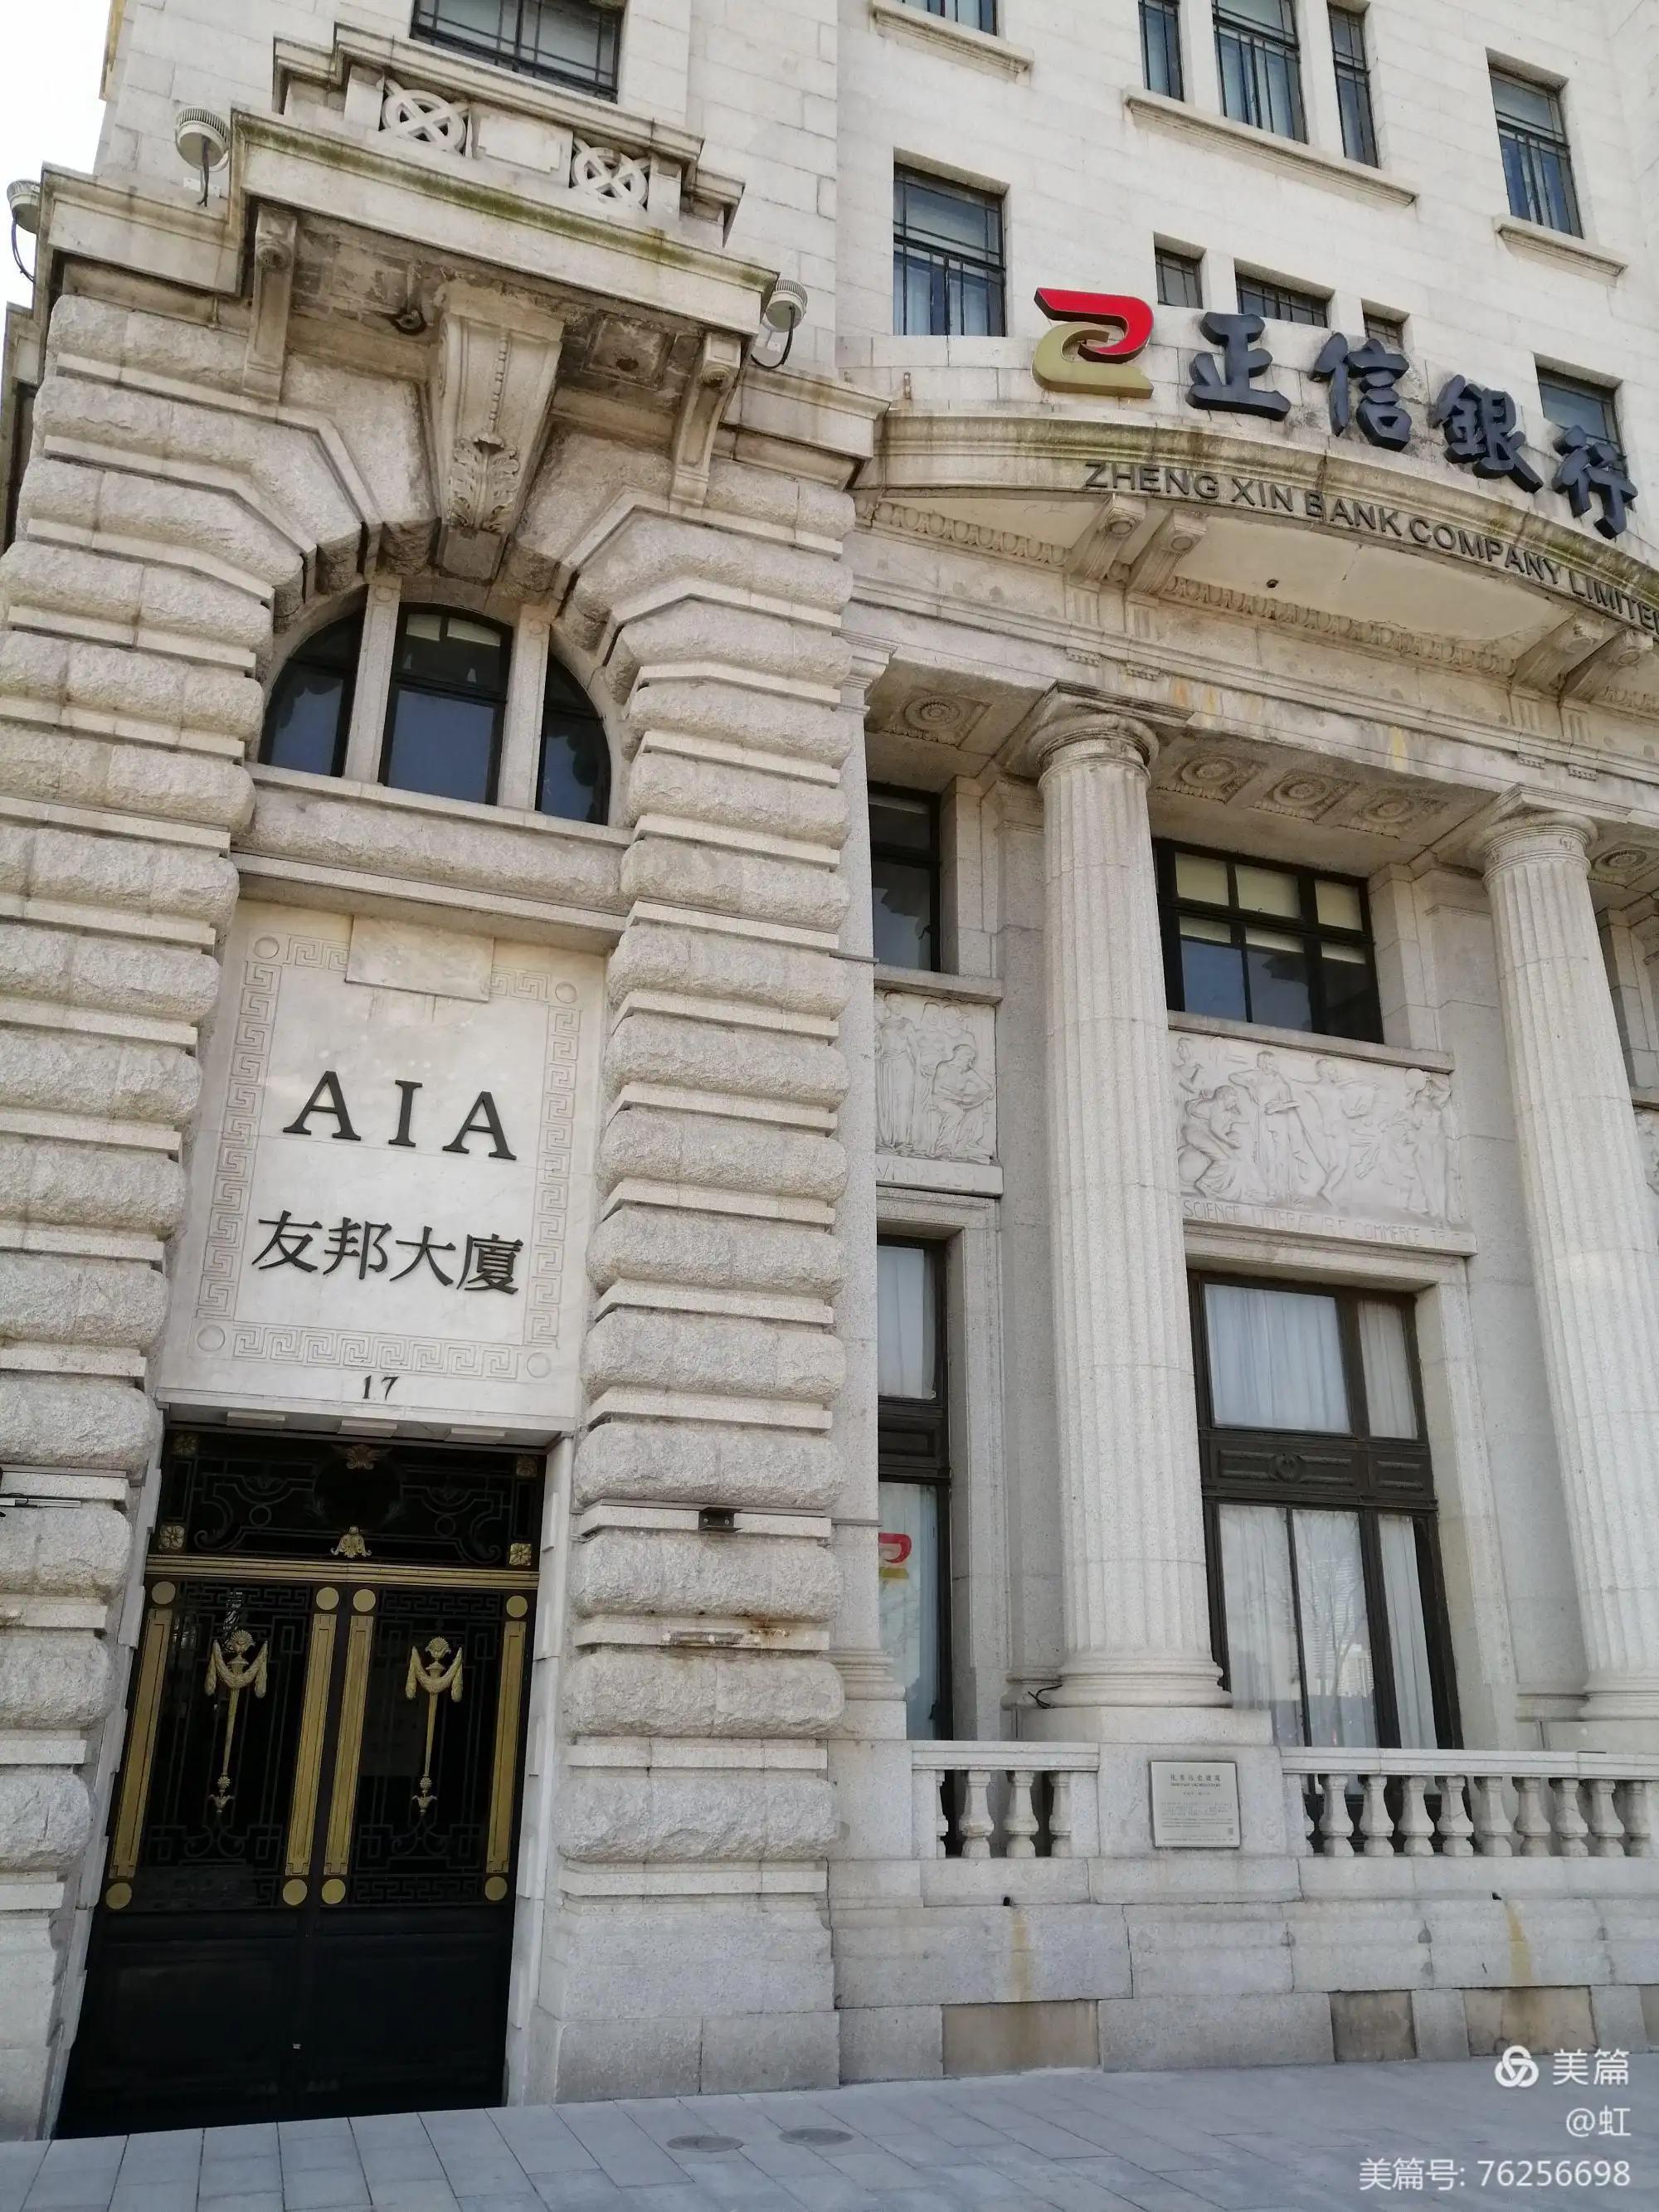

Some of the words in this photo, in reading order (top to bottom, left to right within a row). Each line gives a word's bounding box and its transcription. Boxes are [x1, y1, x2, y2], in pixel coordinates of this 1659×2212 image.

[1186, 312, 1638, 540] 正信銀行
[1083, 462, 1220, 498] ZHENG
[1231, 477, 1295, 513] XIN
[1304, 489, 1402, 537] BANK
[1409, 516, 1561, 585] COMPANY
[282, 1070, 518, 1161] AIA
[251, 1209, 524, 1296] 友邦大廈
[362, 1374, 399, 1401] 17
